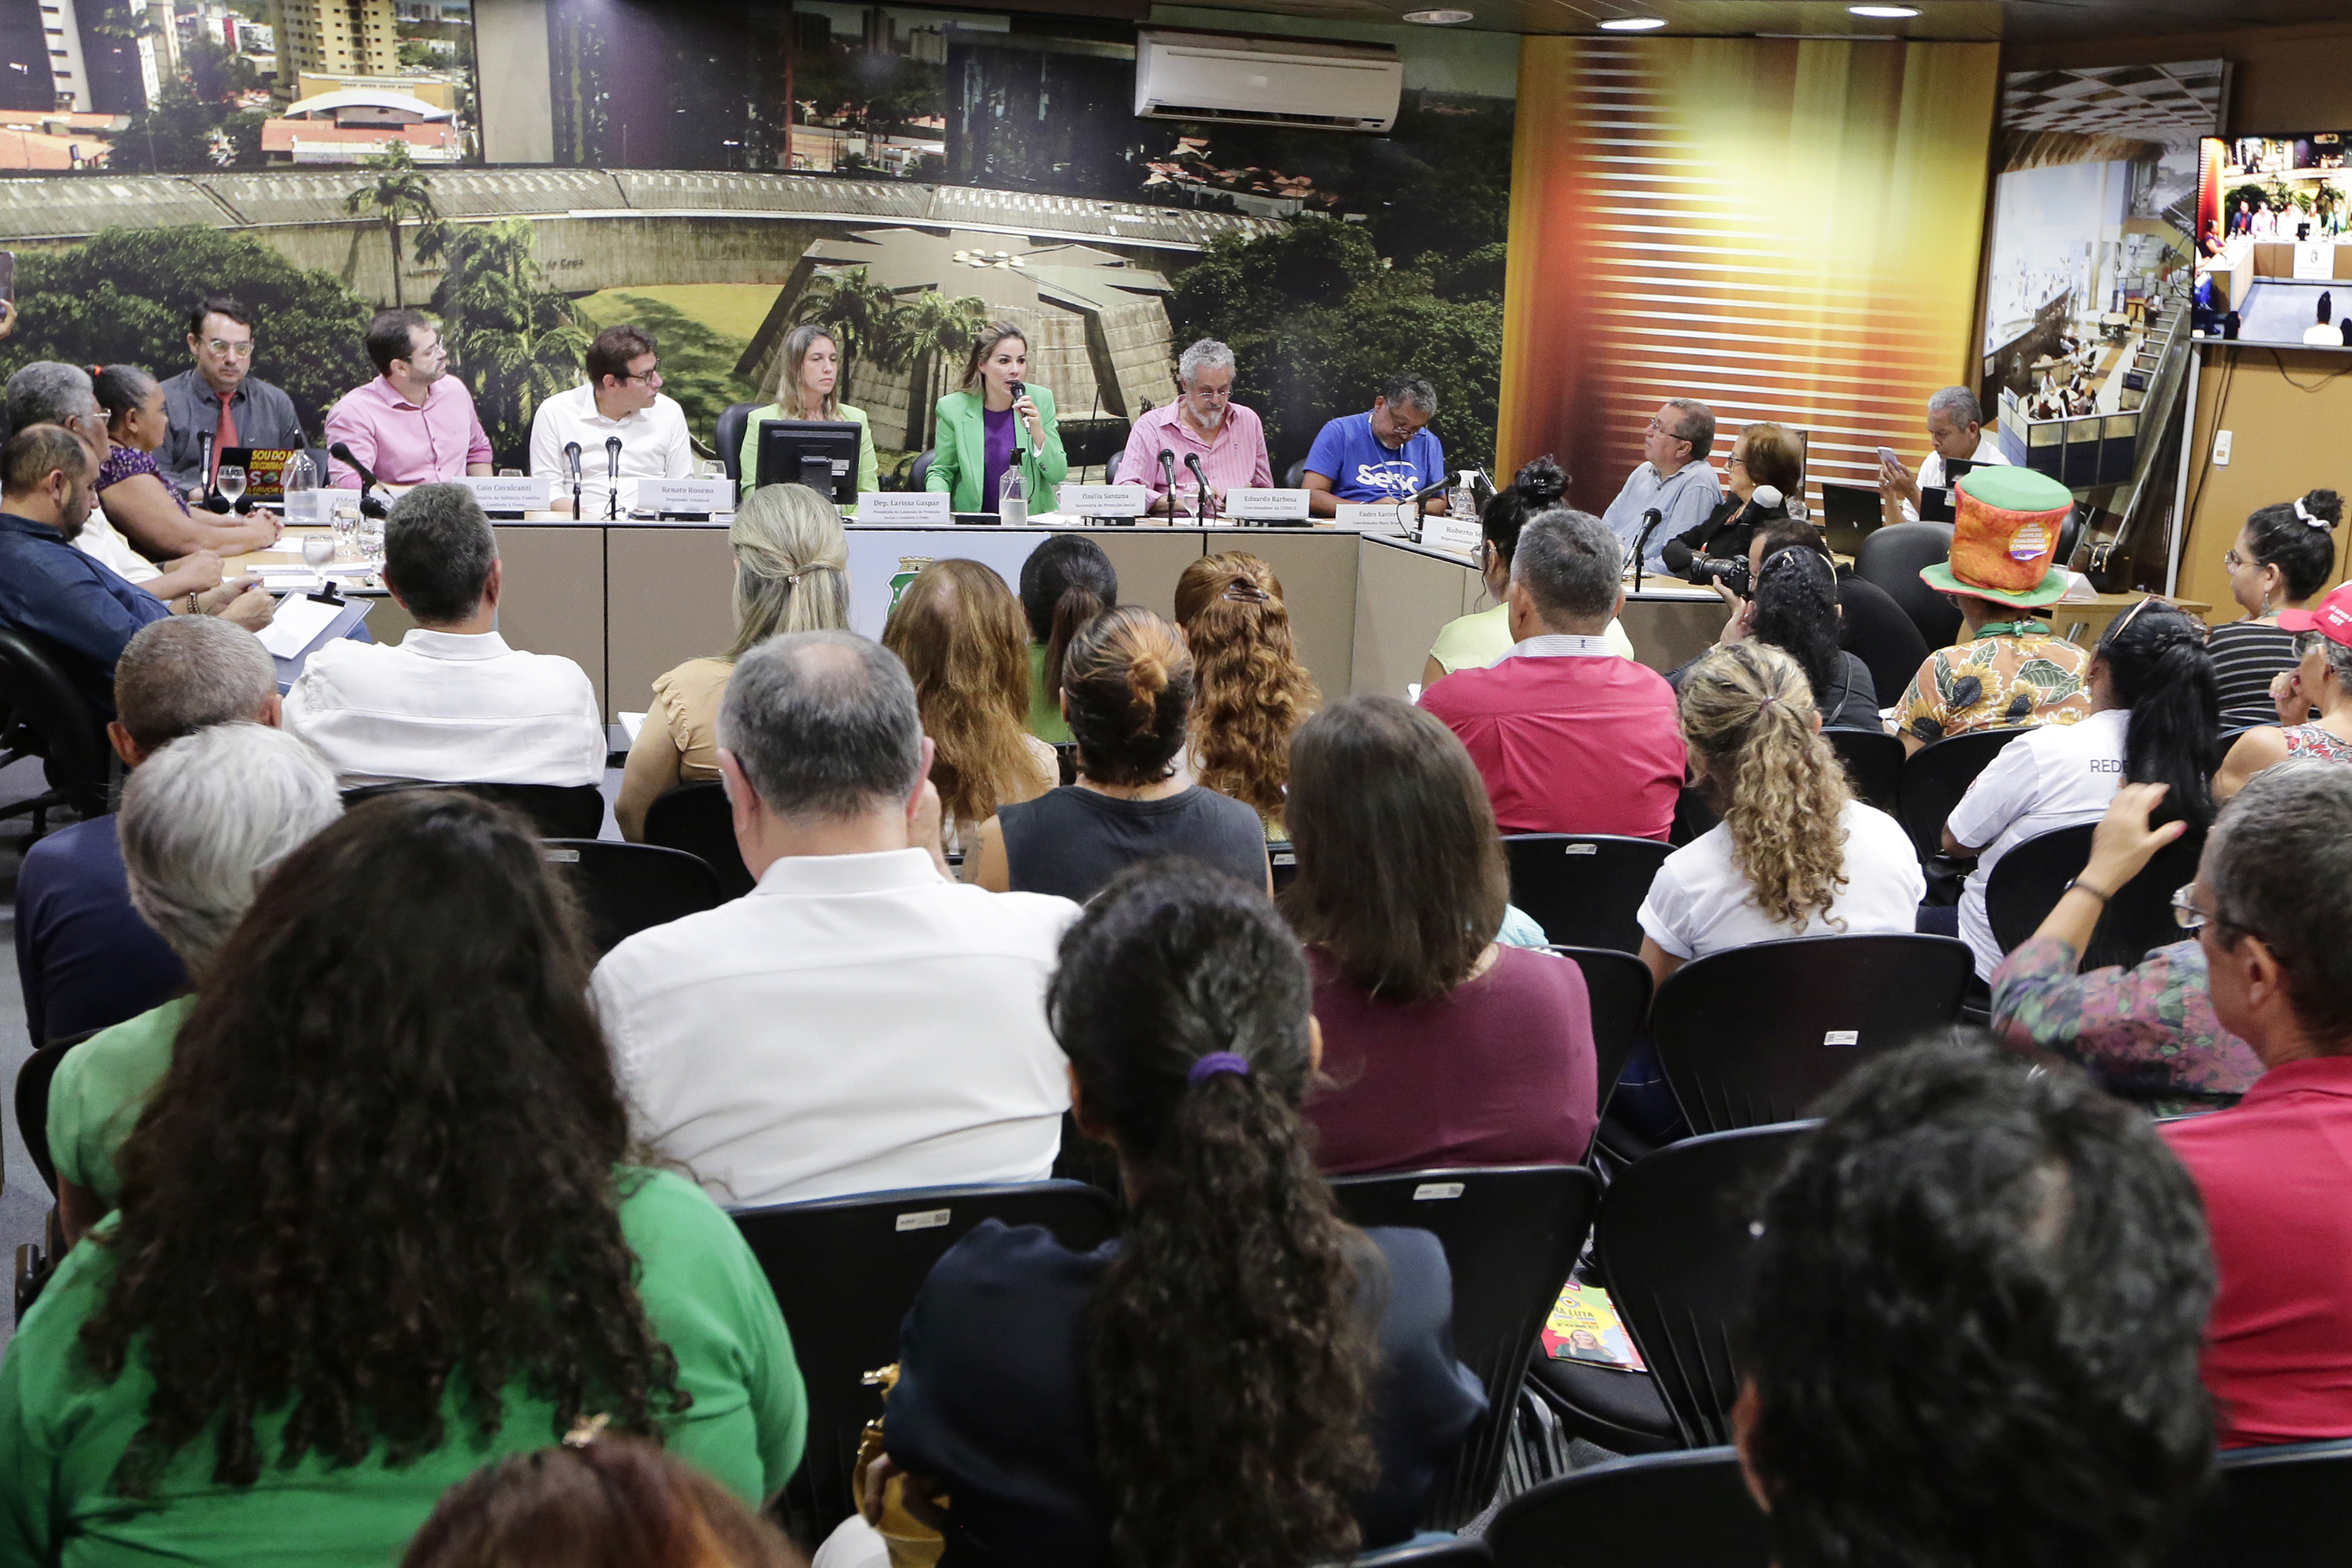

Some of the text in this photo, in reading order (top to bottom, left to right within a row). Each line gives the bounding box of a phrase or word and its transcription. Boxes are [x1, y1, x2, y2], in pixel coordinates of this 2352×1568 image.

[251, 450, 271, 461] SOU
[271, 450, 286, 461] DO
[1446, 526, 1473, 536] Roberto
[1569, 1309, 1595, 1317] LUTA
